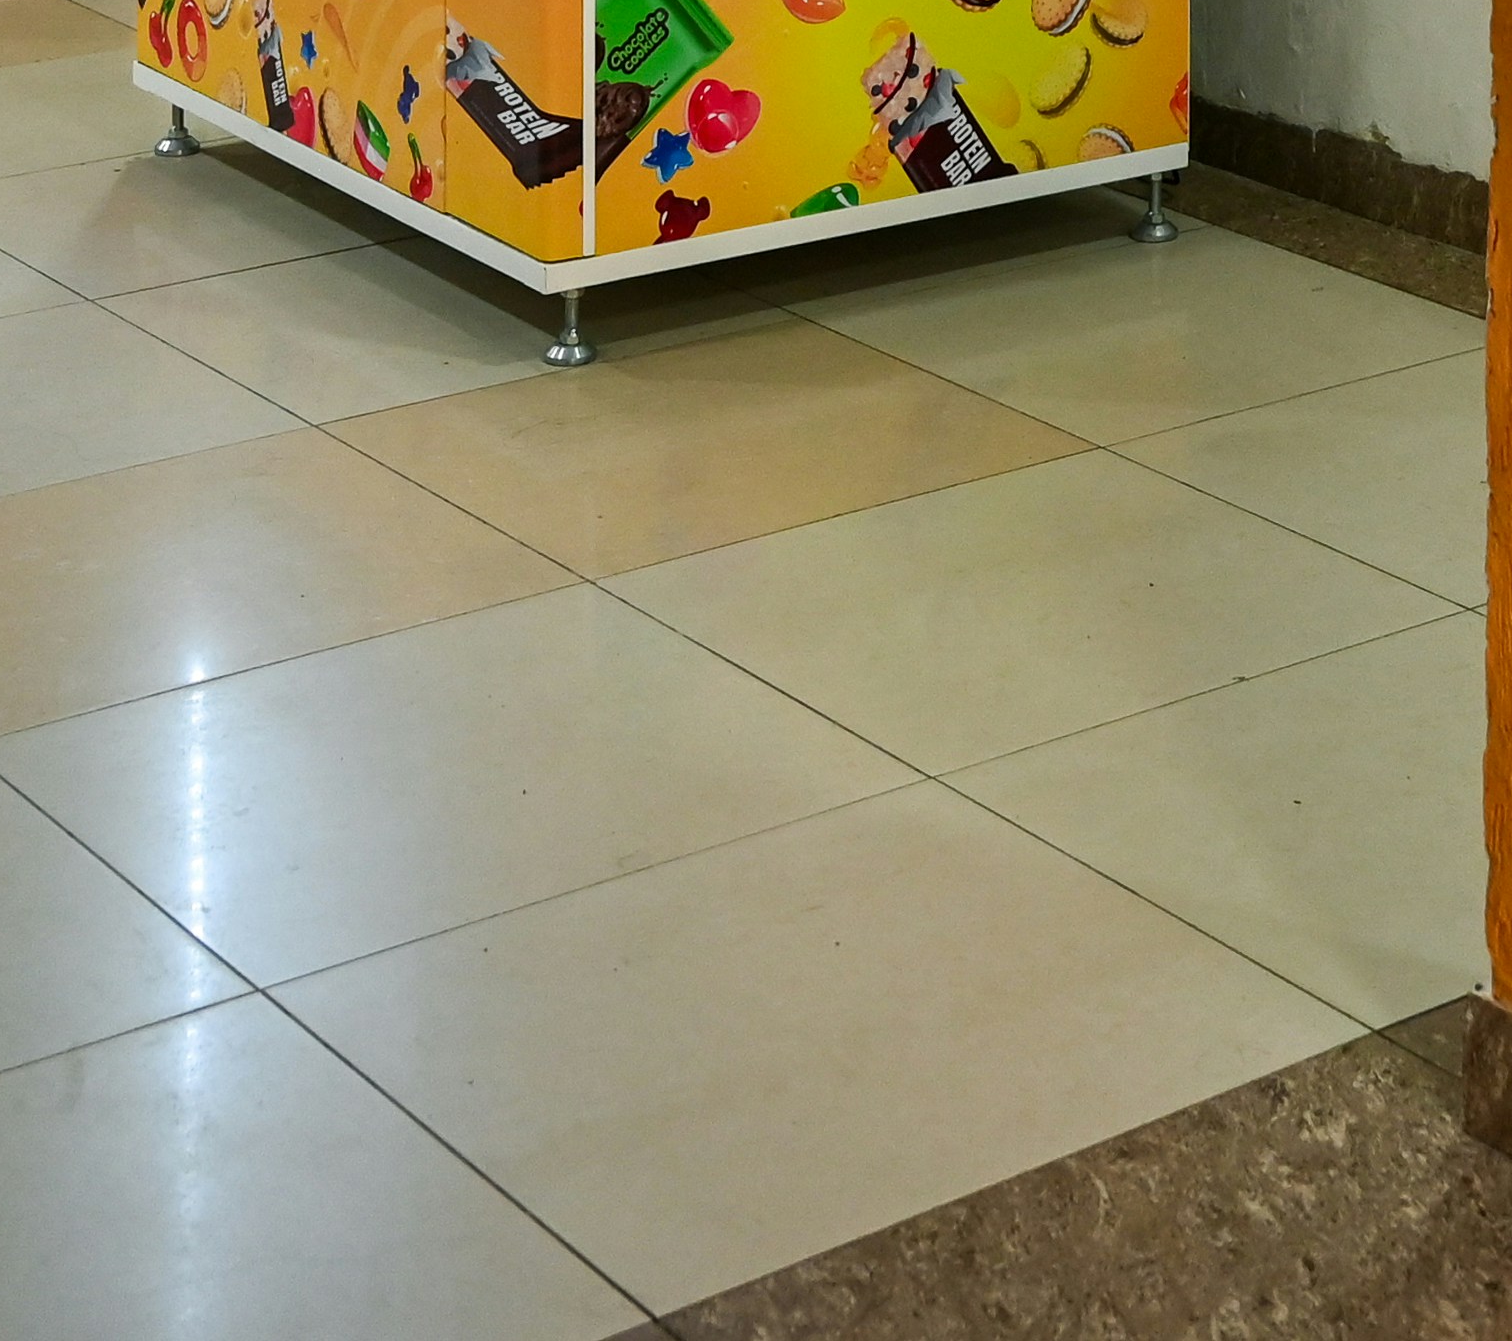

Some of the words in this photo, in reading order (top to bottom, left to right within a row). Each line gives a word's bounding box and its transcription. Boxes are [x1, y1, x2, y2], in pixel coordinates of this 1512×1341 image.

[611, 11, 666, 68] Chocolate
[624, 26, 666, 71] cookies
[494, 71, 570, 140] PROTEIN
[496, 109, 536, 145] BAR
[947, 104, 992, 175] PROTEIN
[940, 149, 973, 186] BAR
